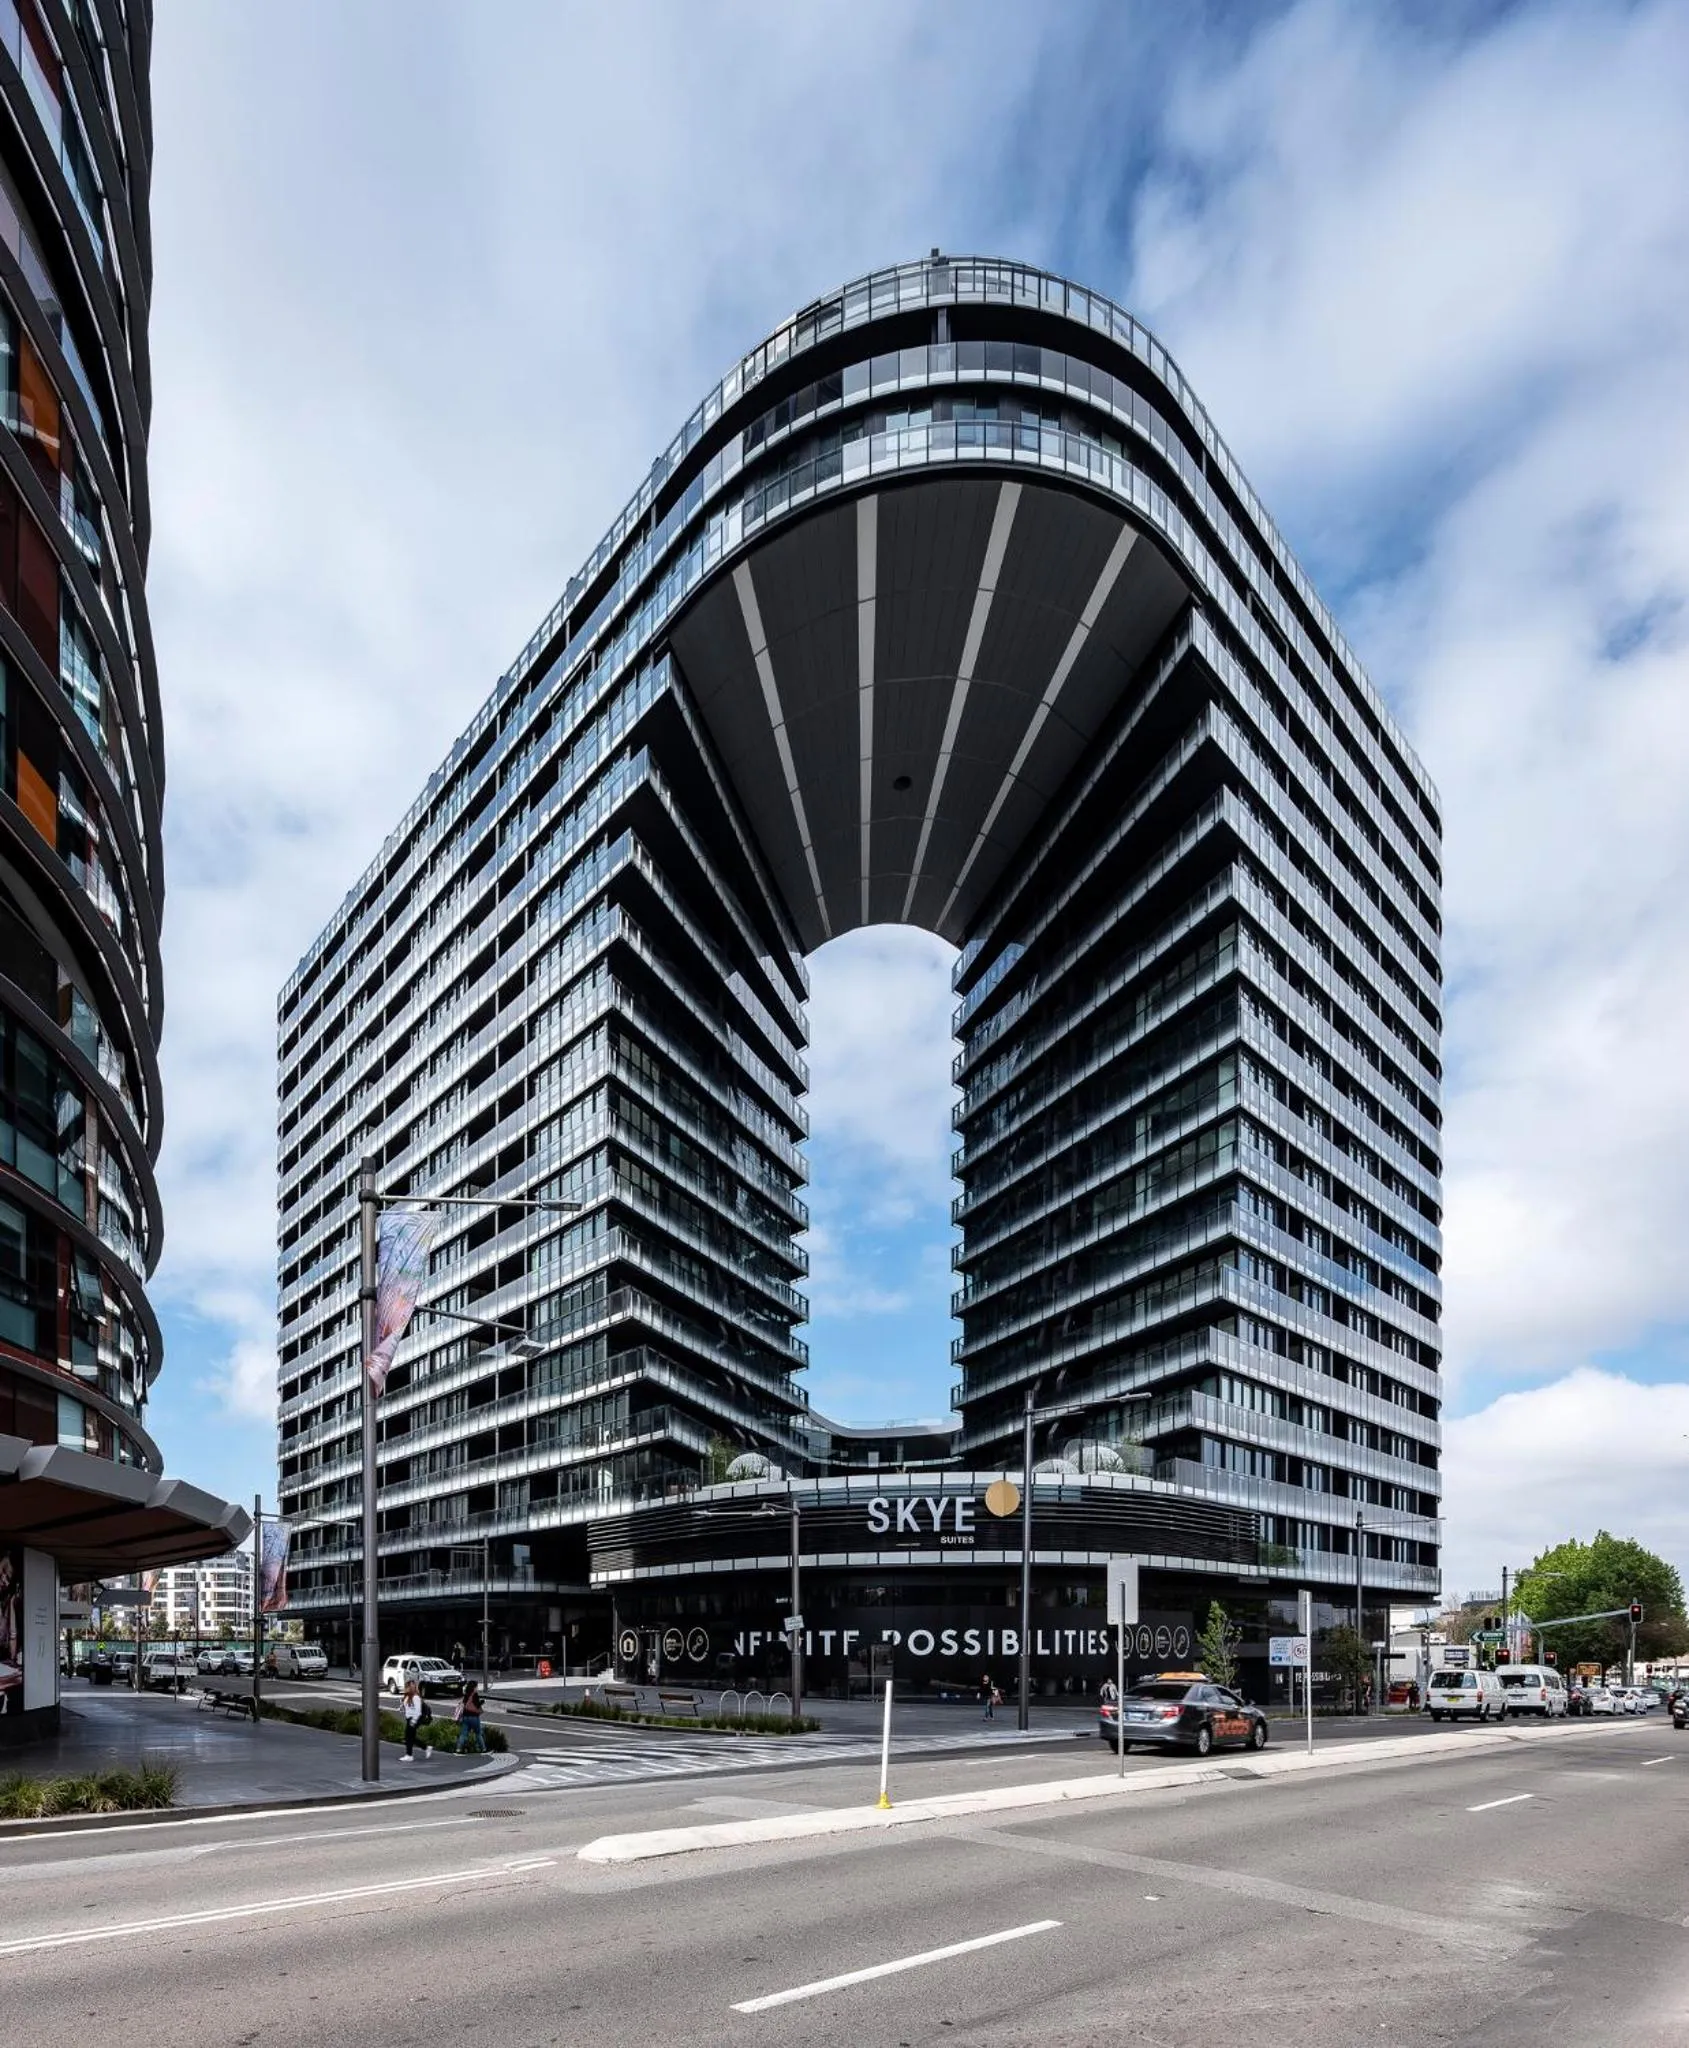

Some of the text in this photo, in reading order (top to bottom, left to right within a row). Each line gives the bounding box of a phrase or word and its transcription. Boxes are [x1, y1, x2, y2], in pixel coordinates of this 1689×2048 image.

[867, 1496, 976, 1533] SKYE
[940, 1535, 975, 1544] SUITES
[733, 1629, 860, 1656] NFITE
